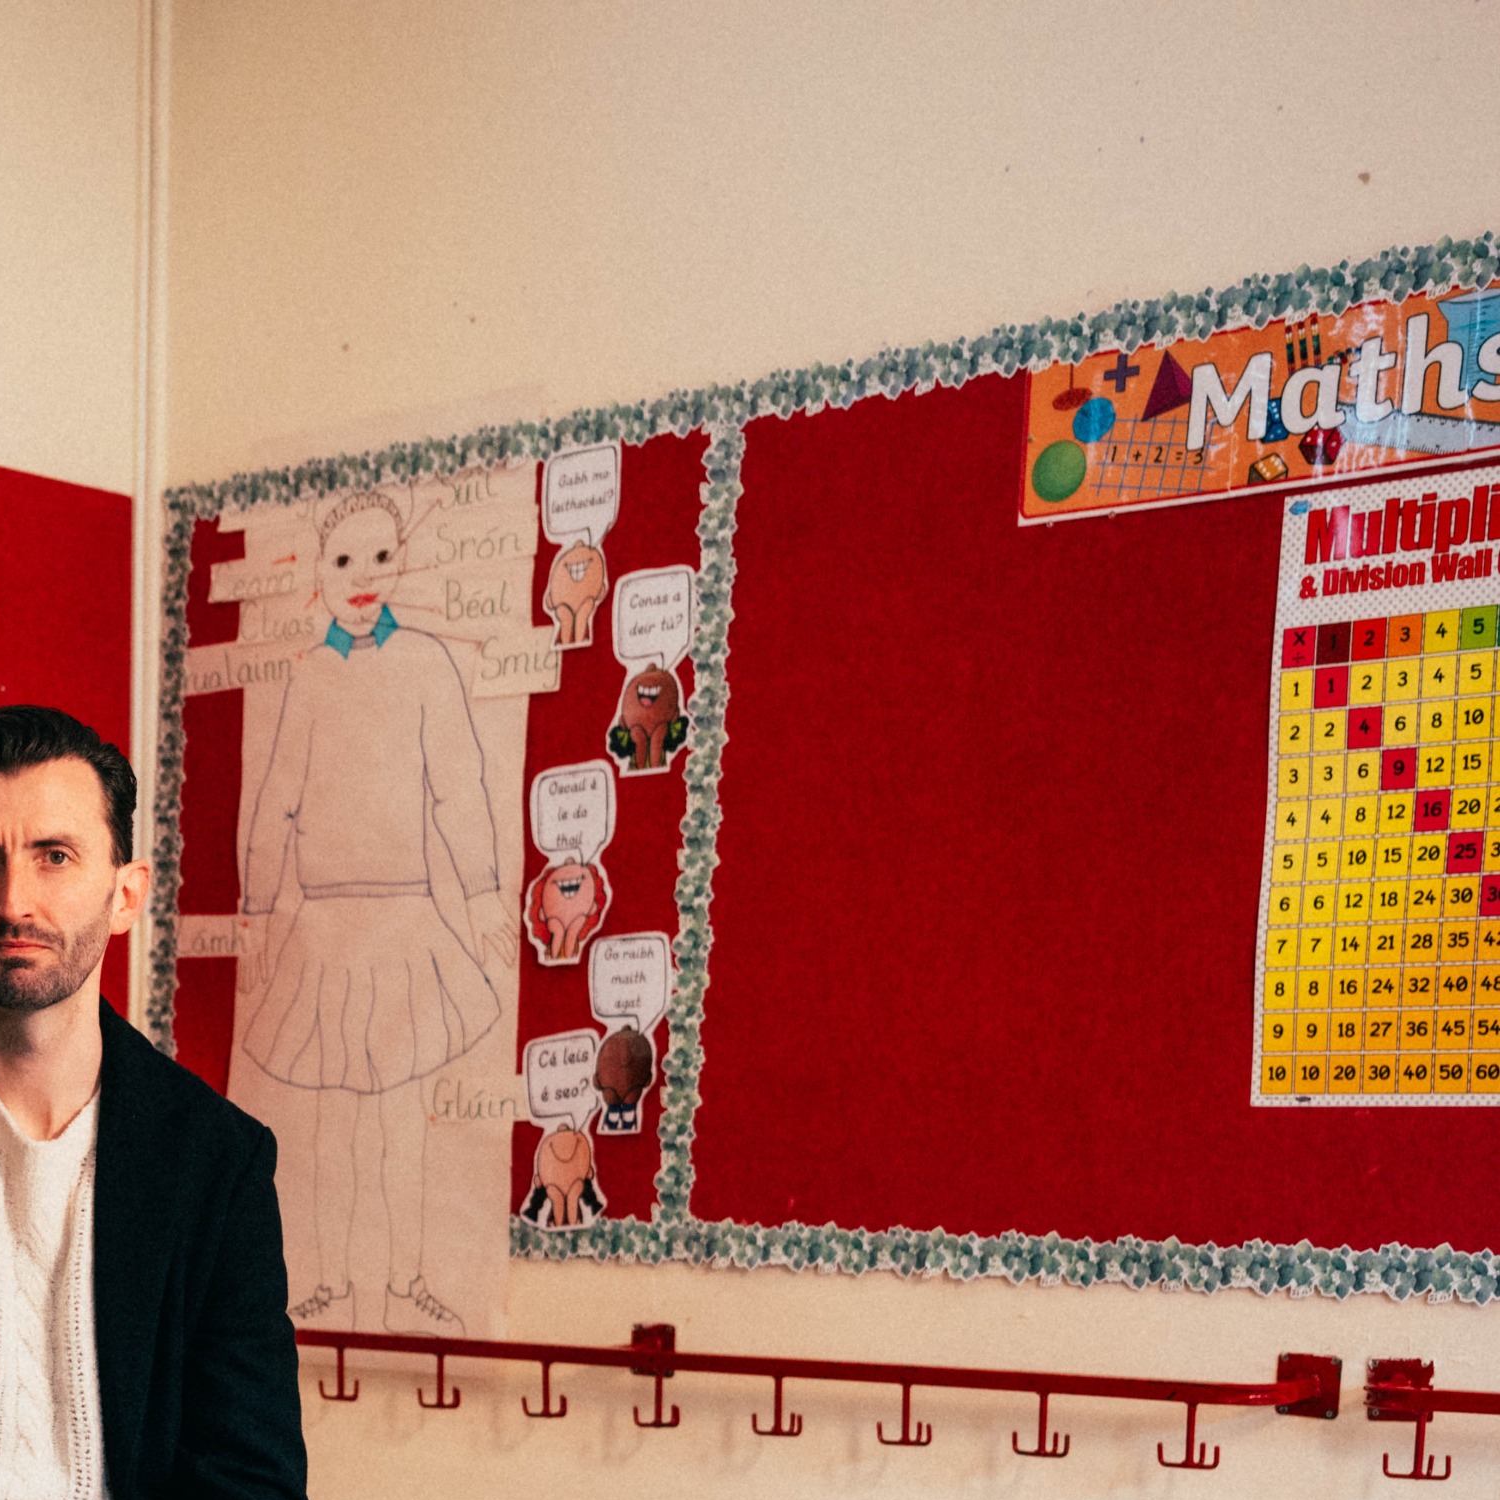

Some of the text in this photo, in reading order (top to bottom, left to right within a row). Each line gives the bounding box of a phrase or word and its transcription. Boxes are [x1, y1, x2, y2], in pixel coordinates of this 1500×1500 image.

[1185, 312, 1500, 451] Maths
[1110, 446, 1118, 463] 1
[1153, 447, 1163, 464] 2
[1193, 449, 1205, 466] 3
[436, 522, 522, 565] Srón
[1299, 548, 1493, 600] & Division Wall
[445, 580, 511, 622] Béal
[629, 593, 668, 609] Conas
[240, 600, 315, 641] Cluas
[1329, 617, 1485, 651] 1 2 3 4 5
[184, 648, 296, 691] ualainn
[481, 635, 560, 689] Smig
[1293, 663, 1482, 697] 1 1 2 3 4 5
[1289, 708, 1485, 741] 2 2 4 6 8 10
[1289, 753, 1482, 784] 3 3 6 9 12 15
[1286, 798, 1481, 827] 4 4 8 12 16 20
[1283, 842, 1477, 870] 5 5 10 15 20 25
[1279, 887, 1474, 912] 6 6 12 18 24 30
[1277, 939, 1287, 954] 7
[1311, 938, 1322, 953] 7
[1341, 936, 1360, 952] 14
[1376, 934, 1394, 951] 21
[1410, 933, 1433, 949] 28
[1447, 931, 1470, 948] 35
[611, 971, 647, 985] maith
[1274, 982, 1285, 997] 8
[1308, 981, 1319, 996] 8
[1339, 979, 1358, 995] 16
[1371, 978, 1395, 994] 24
[1408, 977, 1430, 993] 32
[1443, 976, 1469, 992] 40
[1272, 1019, 1500, 1039] 9 9 18 27 36 45 54
[538, 1049, 589, 1068] Cé leis
[1268, 1063, 1500, 1081] 10 10 20 30 40 50 60
[432, 1078, 522, 1119] Glúin
[554, 1078, 589, 1100] seo?
